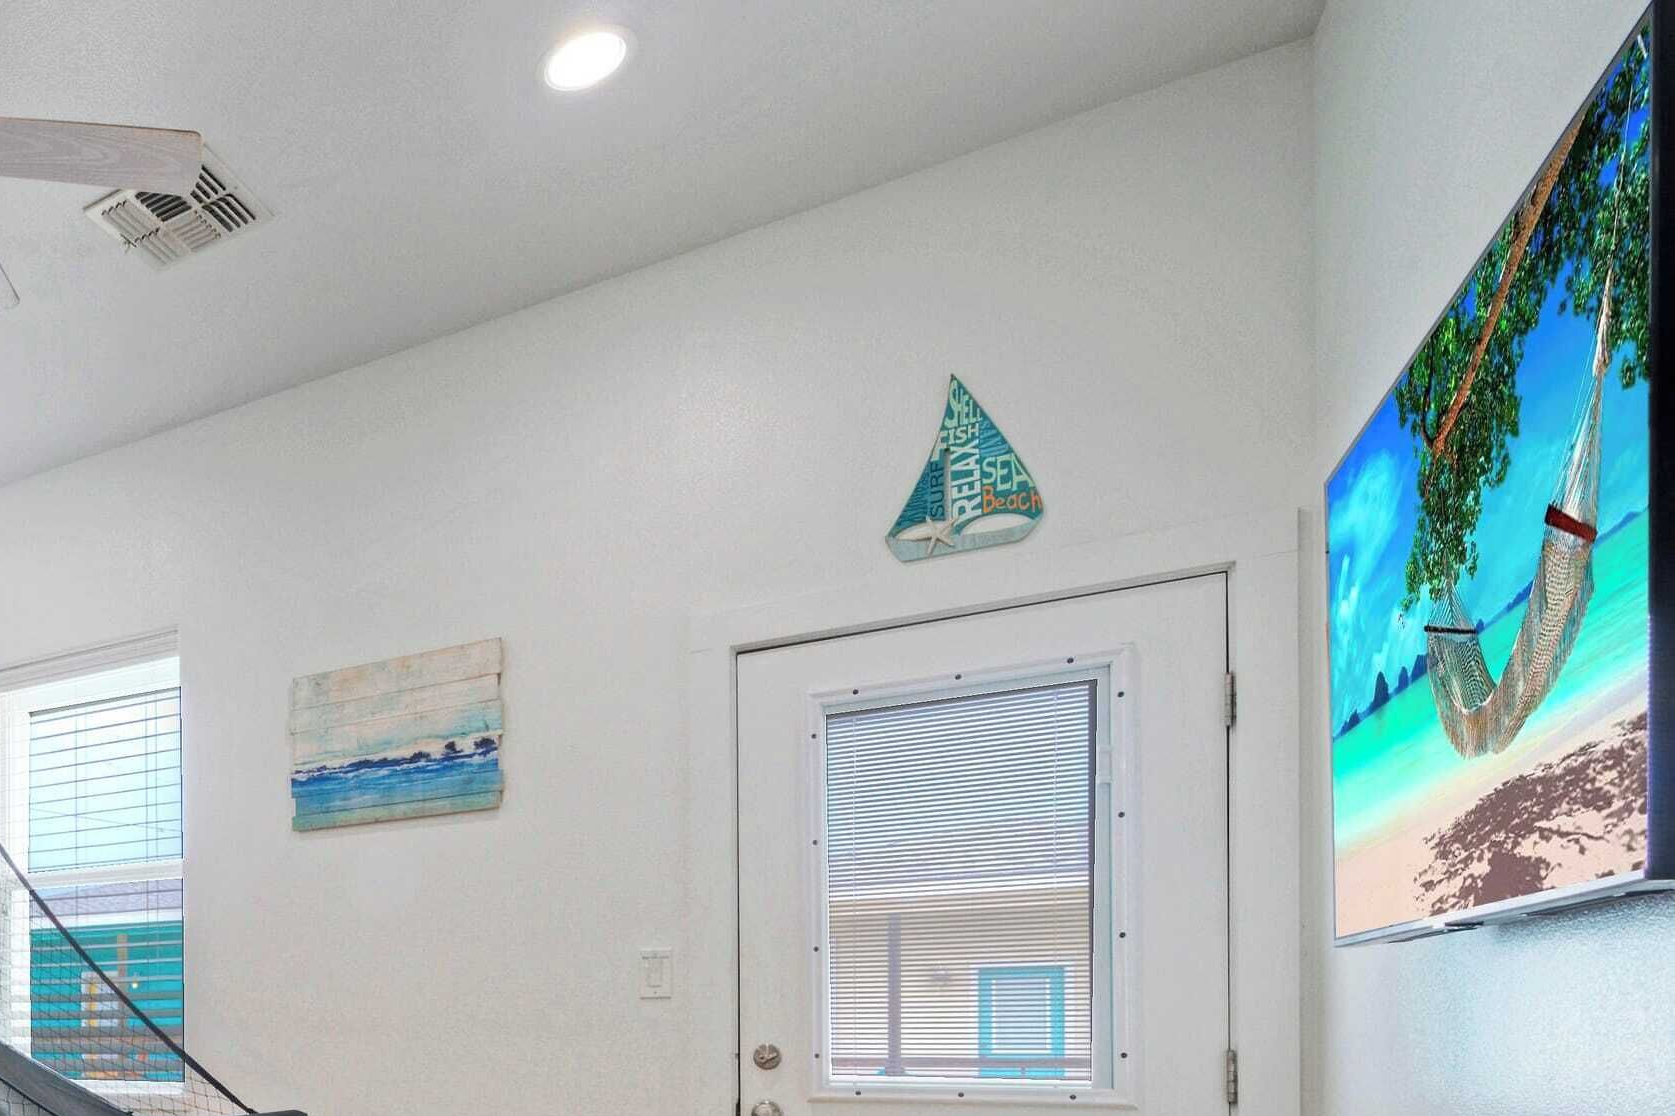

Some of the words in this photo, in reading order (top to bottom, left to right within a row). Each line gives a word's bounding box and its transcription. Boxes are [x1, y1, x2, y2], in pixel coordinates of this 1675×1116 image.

[931, 422, 980, 461] FISH
[930, 462, 945, 520] SURF
[950, 437, 982, 527] RELAX
[982, 453, 1037, 491] SEA
[982, 485, 1043, 514] Beach
